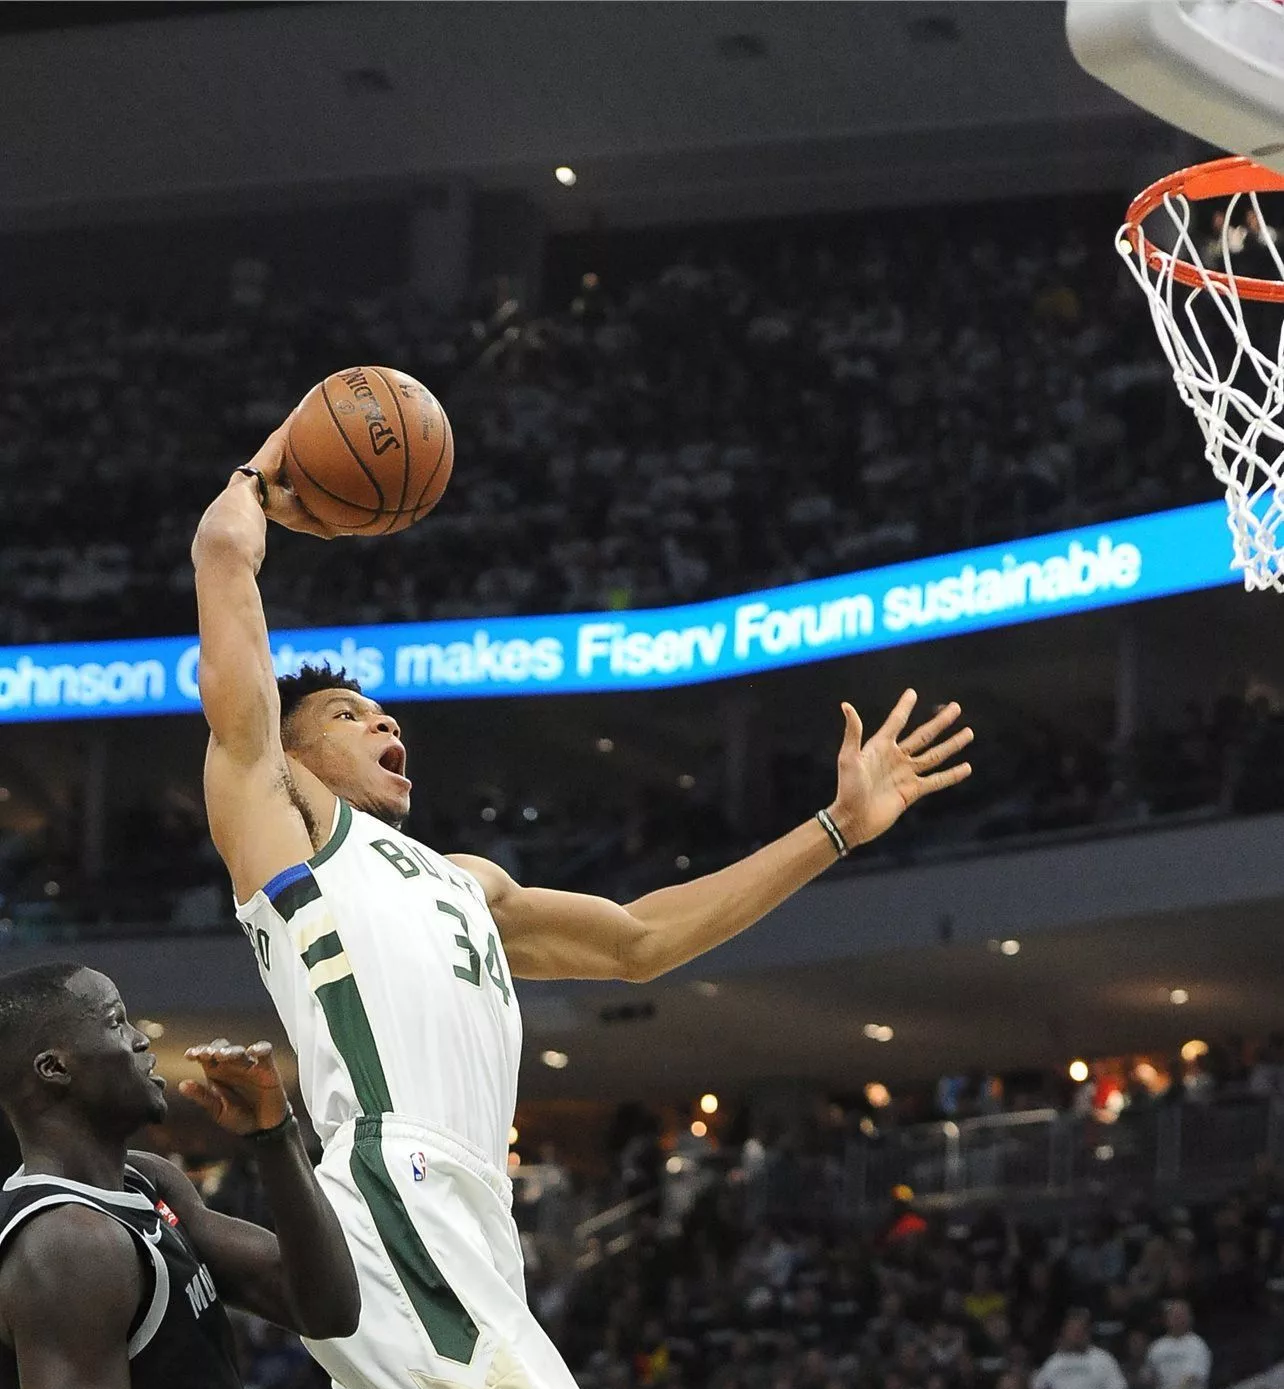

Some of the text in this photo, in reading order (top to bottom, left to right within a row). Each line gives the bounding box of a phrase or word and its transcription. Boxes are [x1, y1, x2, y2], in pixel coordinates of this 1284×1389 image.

[395, 629, 563, 690] makes
[578, 619, 727, 680] Fiserv
[735, 589, 874, 659] Forum
[883, 534, 1142, 631] sustainable
[434, 898, 511, 1008] 34
